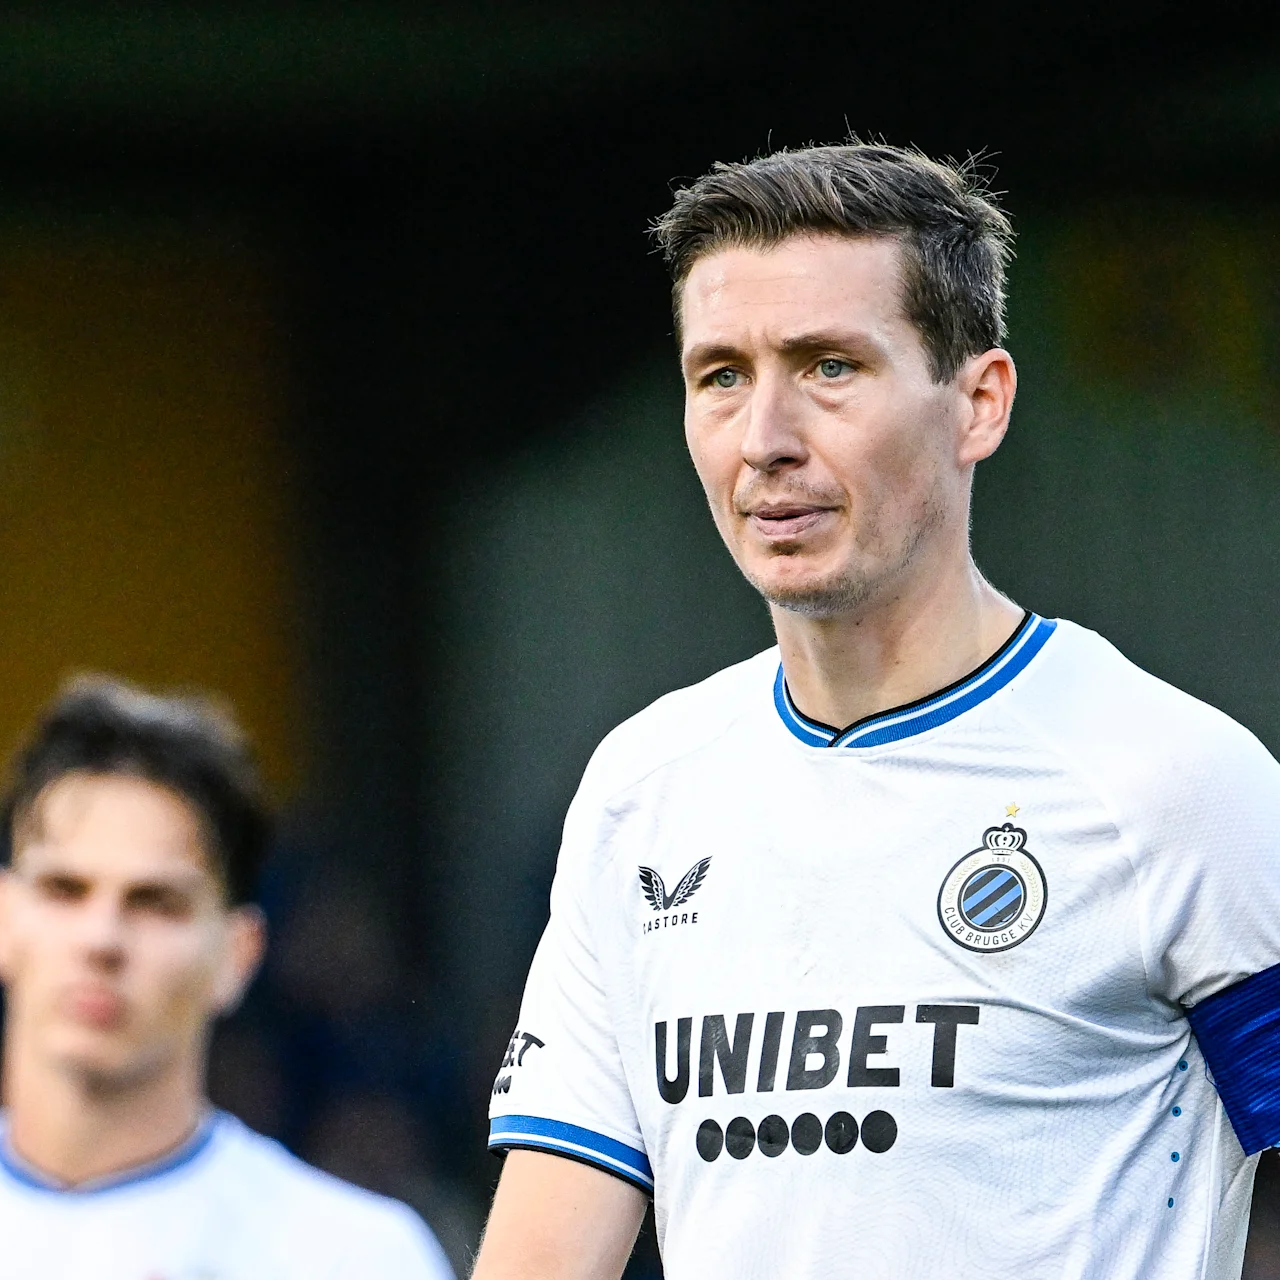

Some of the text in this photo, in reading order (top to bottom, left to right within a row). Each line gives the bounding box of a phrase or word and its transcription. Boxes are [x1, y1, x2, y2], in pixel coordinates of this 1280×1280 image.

[643, 912, 699, 935] CASTORE
[944, 906, 1034, 946] CLUB BRUGGE KV
[654, 1004, 980, 1105] UNIBET
